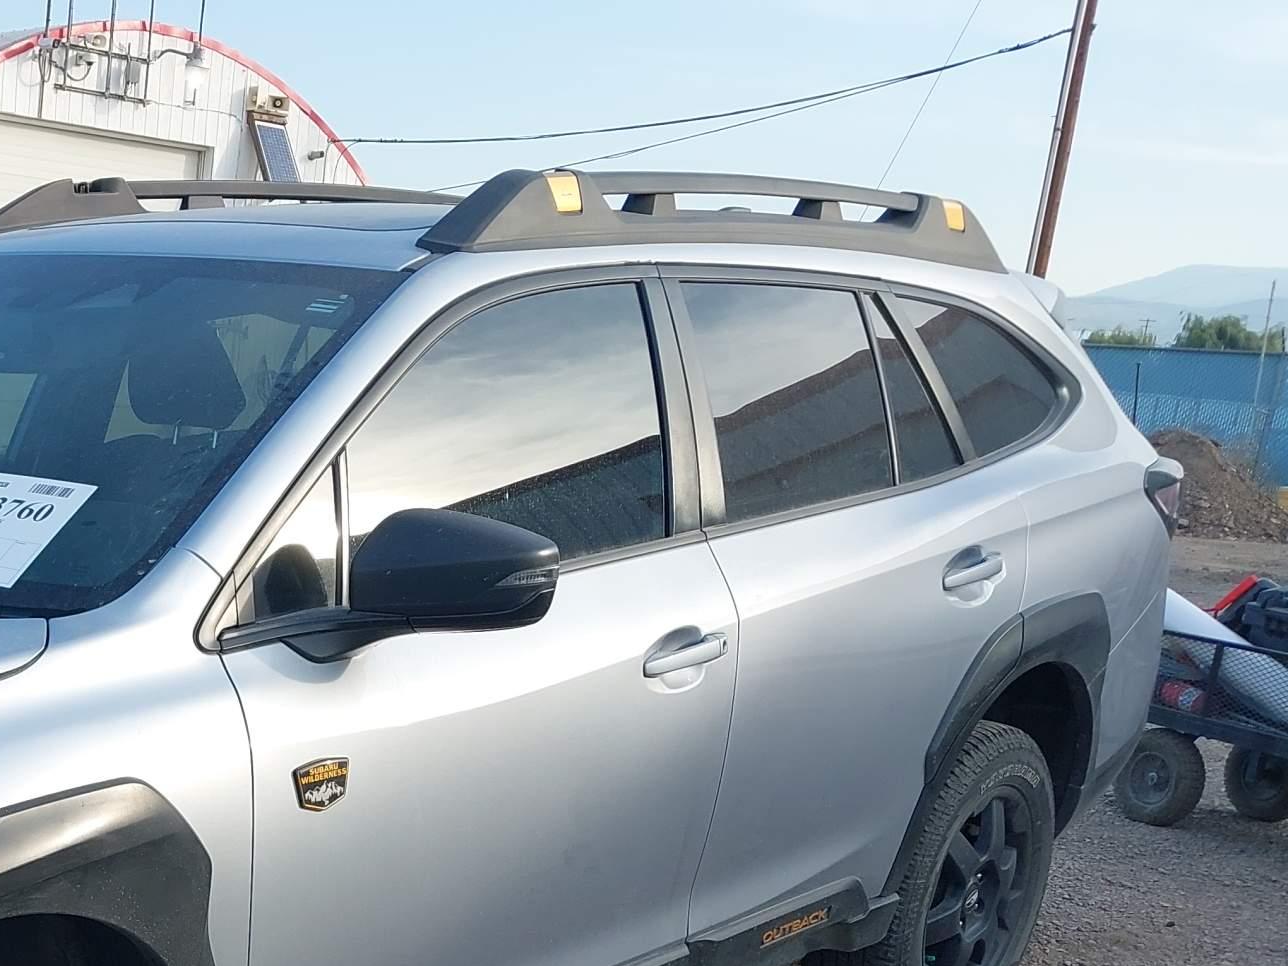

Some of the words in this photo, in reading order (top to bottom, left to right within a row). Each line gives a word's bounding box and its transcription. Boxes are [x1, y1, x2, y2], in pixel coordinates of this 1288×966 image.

[300, 767, 347, 785] WILDERNESS
[309, 762, 339, 775] SUBARU
[762, 907, 829, 944] OUTBACK
